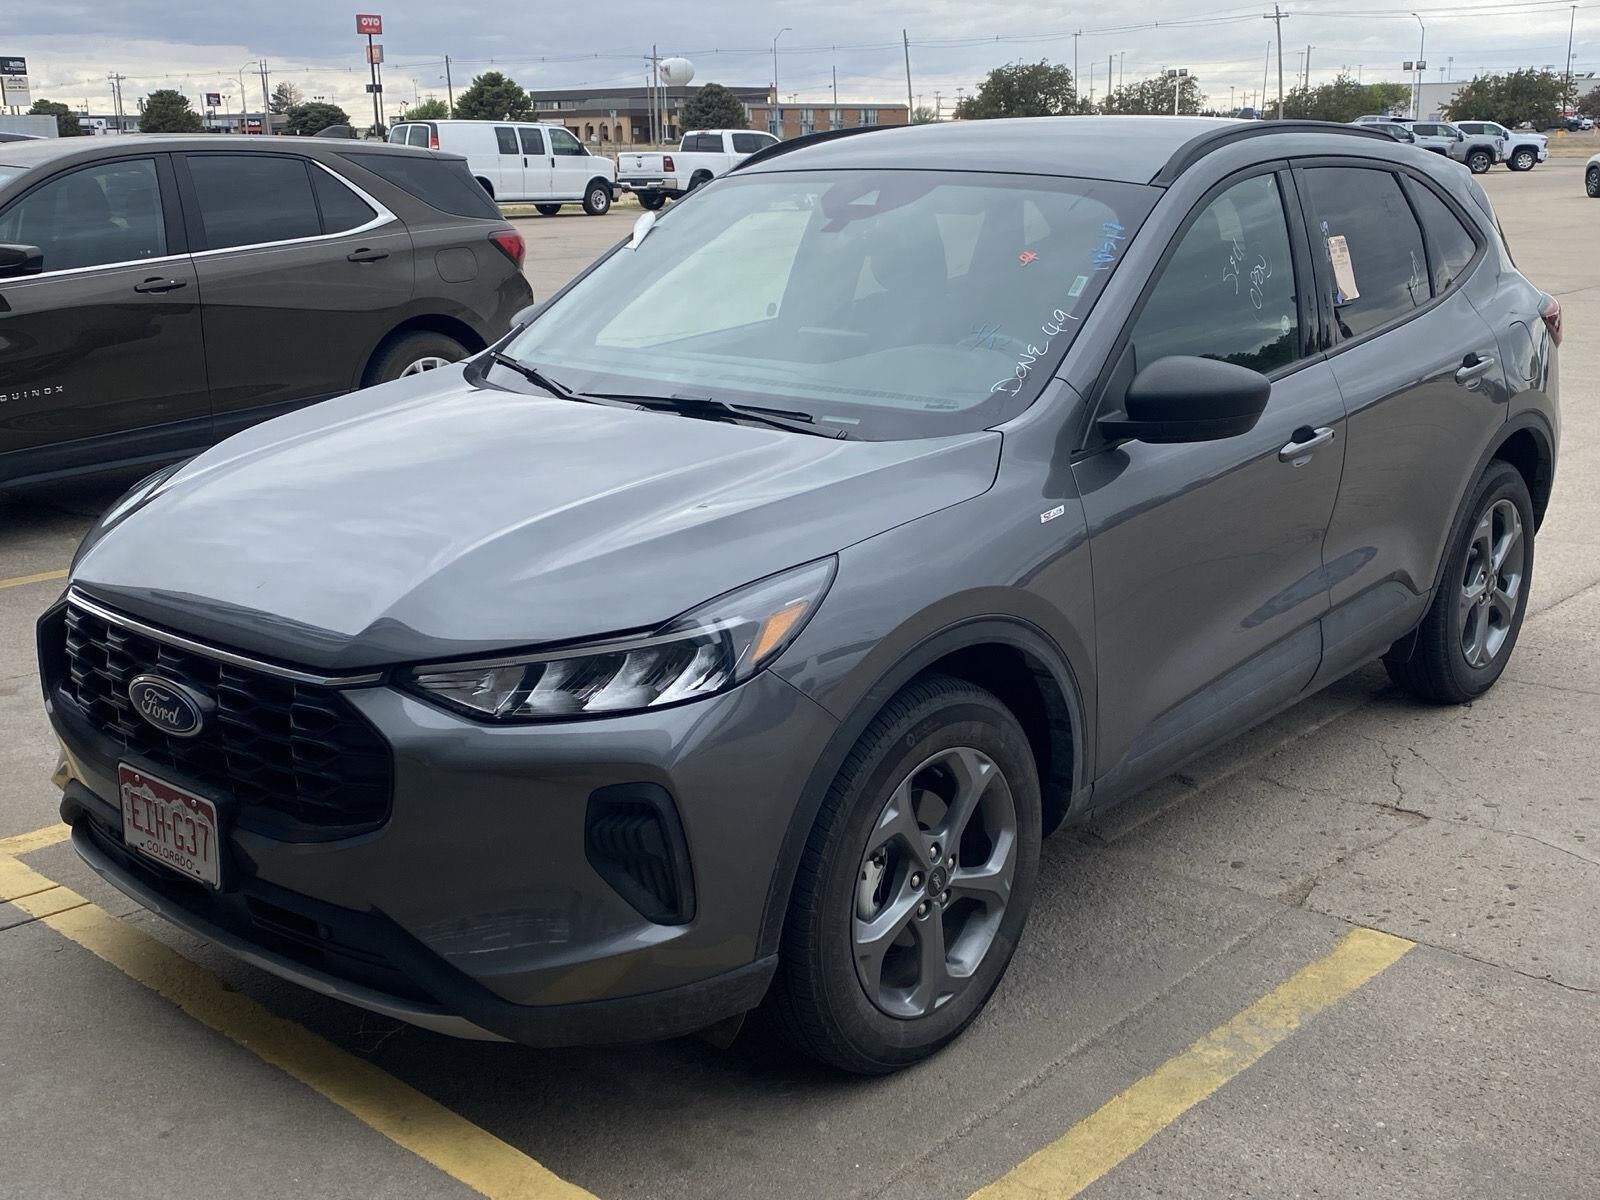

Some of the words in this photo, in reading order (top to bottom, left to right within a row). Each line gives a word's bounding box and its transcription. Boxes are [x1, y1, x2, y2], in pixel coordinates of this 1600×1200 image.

[361, 17, 380, 26] OYO
[990, 340, 1050, 397] DONE
[141, 687, 180, 727] Ford
[146, 839, 193, 870] COLORADO
